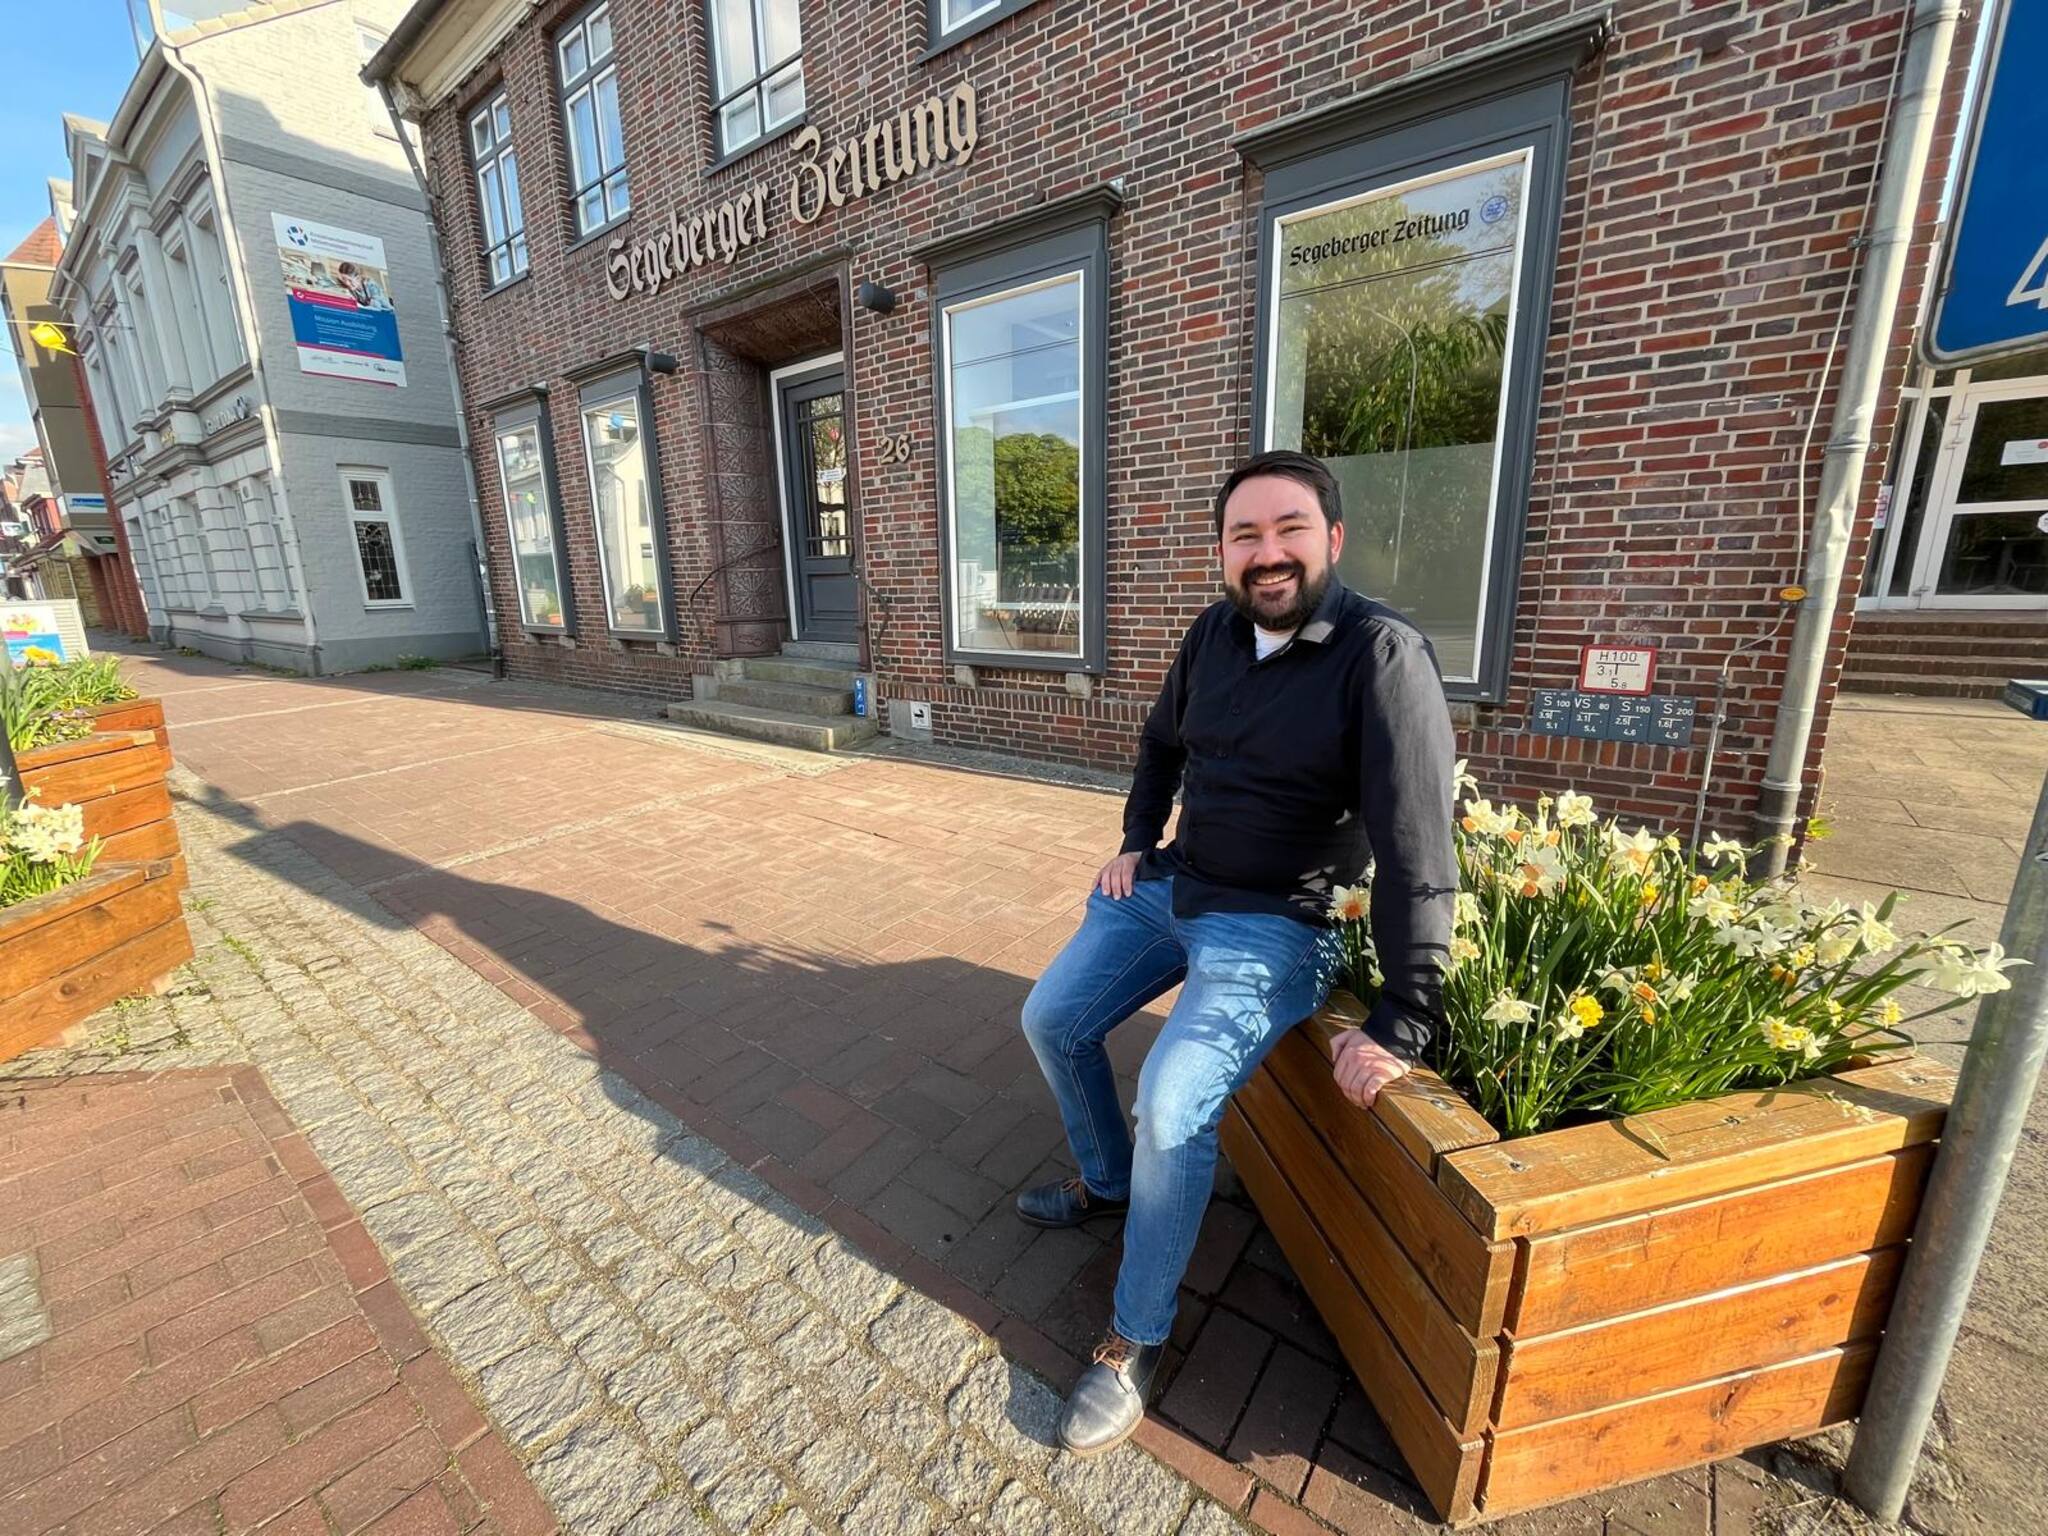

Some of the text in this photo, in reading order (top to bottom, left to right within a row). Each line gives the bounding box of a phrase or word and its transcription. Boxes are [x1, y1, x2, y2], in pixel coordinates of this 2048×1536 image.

[605, 80, 978, 301] Segeberger Zeitung
[1289, 227, 1389, 267] Segeberger
[1392, 208, 1470, 243] Zeitung
[880, 433, 911, 464] 26
[1574, 697, 1592, 709] VS
